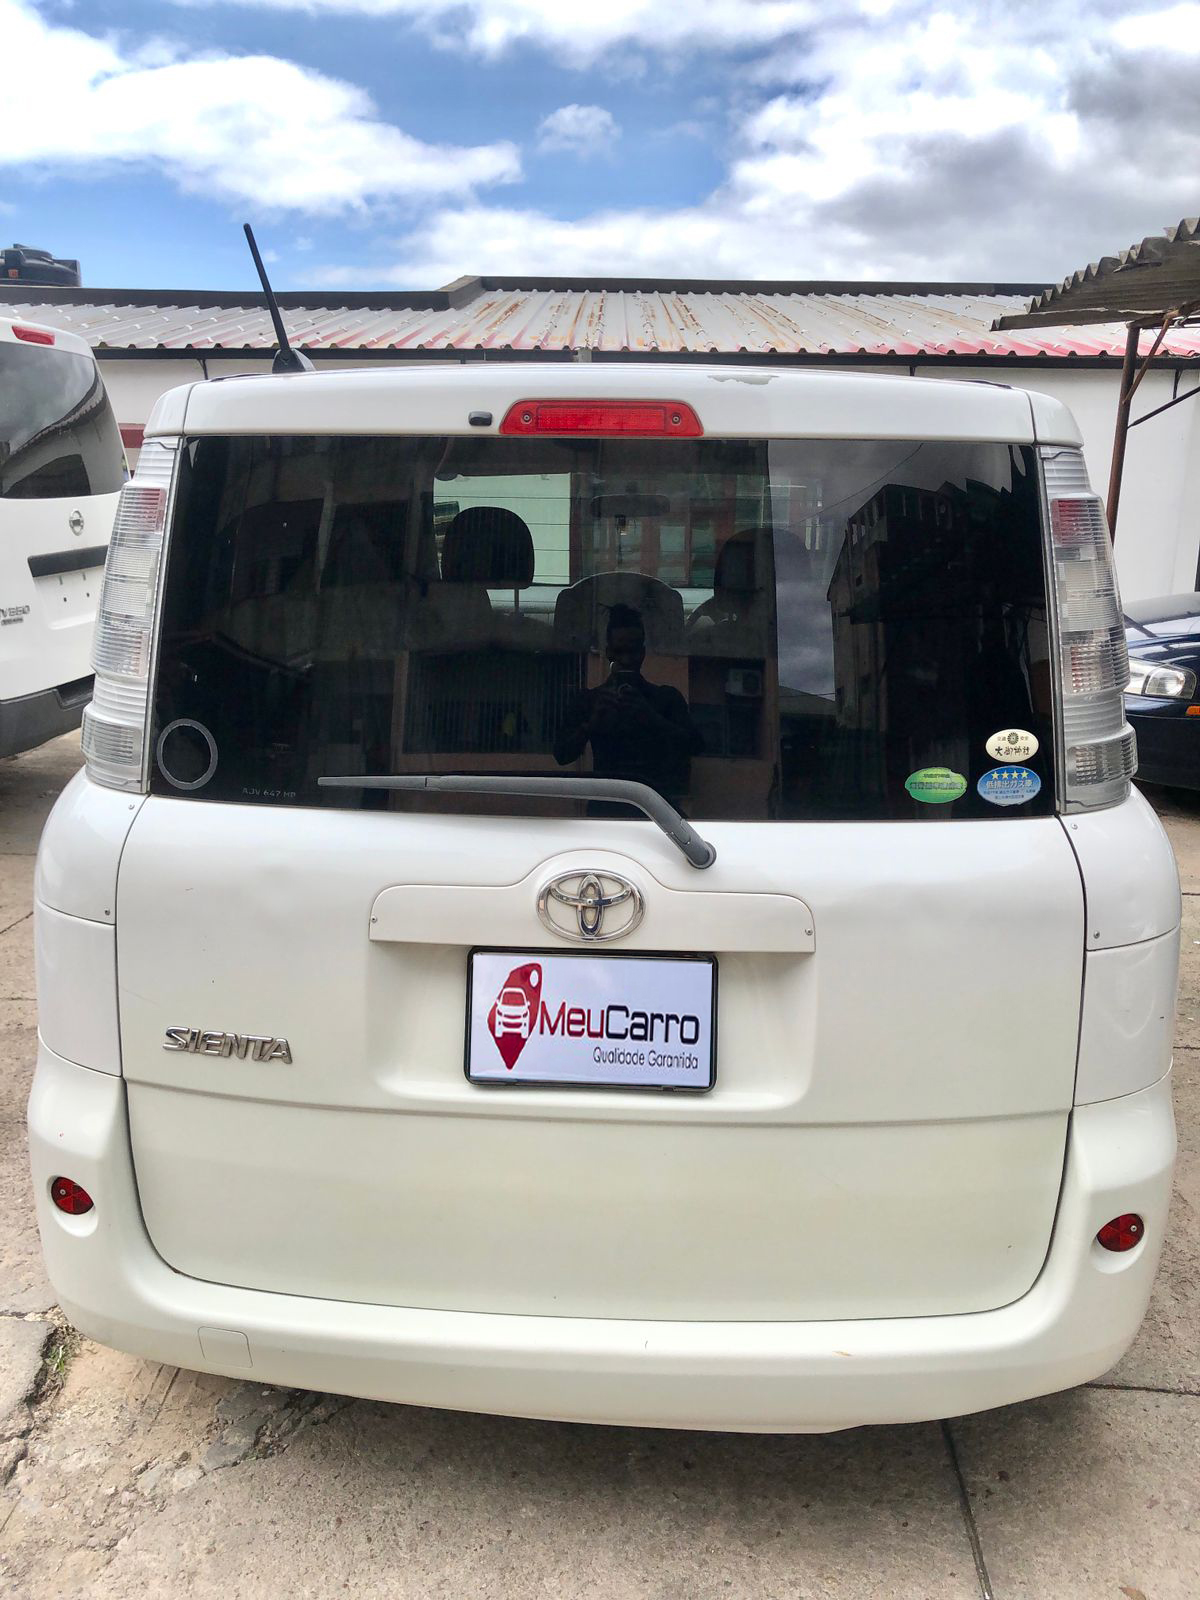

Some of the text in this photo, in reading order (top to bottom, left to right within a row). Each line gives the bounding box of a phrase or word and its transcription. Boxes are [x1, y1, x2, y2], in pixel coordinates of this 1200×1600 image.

[539, 1000, 700, 1045] MeuCarro
[162, 1025, 293, 1064] SIENTA
[593, 1046, 699, 1070] Qualidade Garantida
